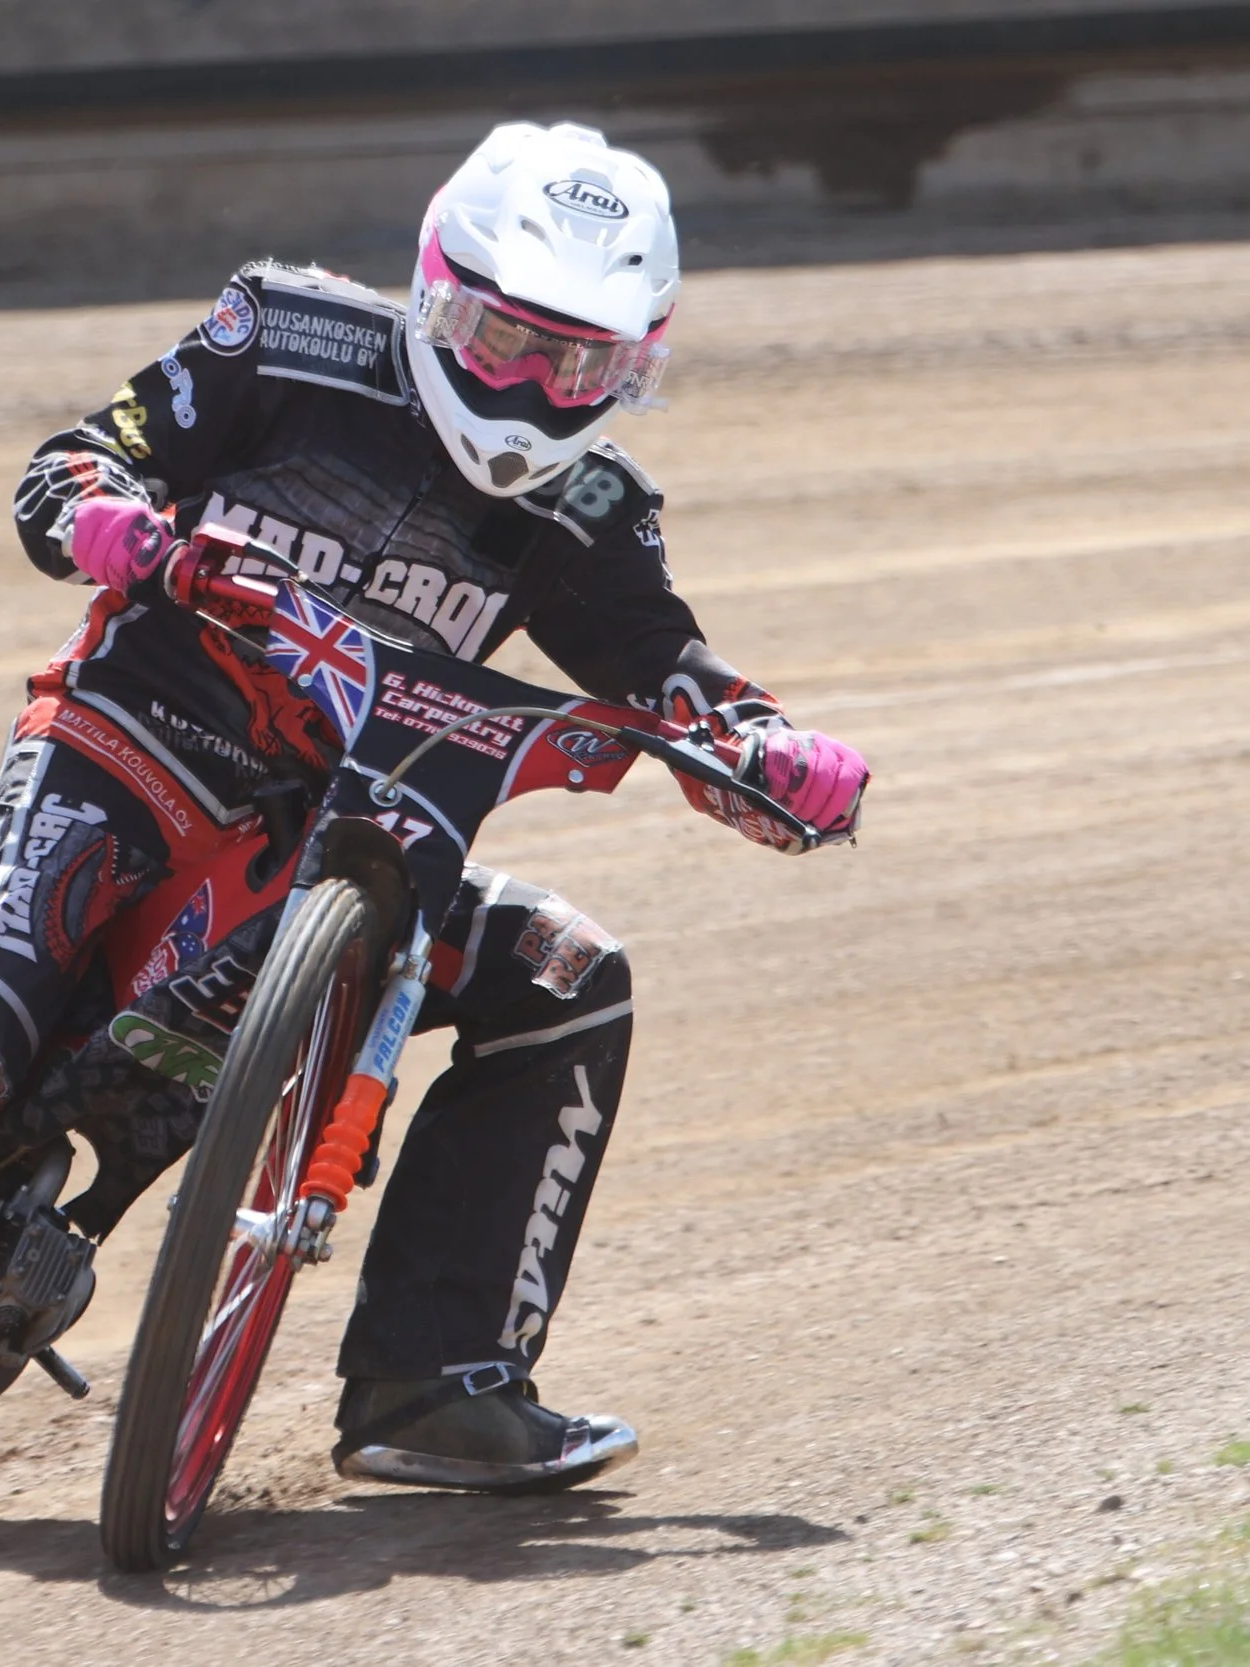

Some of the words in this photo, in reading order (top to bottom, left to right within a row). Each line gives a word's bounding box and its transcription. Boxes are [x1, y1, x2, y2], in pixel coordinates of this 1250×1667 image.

[549, 182, 619, 213] Arai
[259, 328, 354, 364] AUTOKOULU
[356, 348, 378, 370] OY
[507, 434, 532, 451] Arai
[382, 673, 406, 690] G.
[57, 708, 119, 752] MATTILA
[117, 746, 177, 812] KOUVOLA
[373, 989, 412, 1074] FALCON
